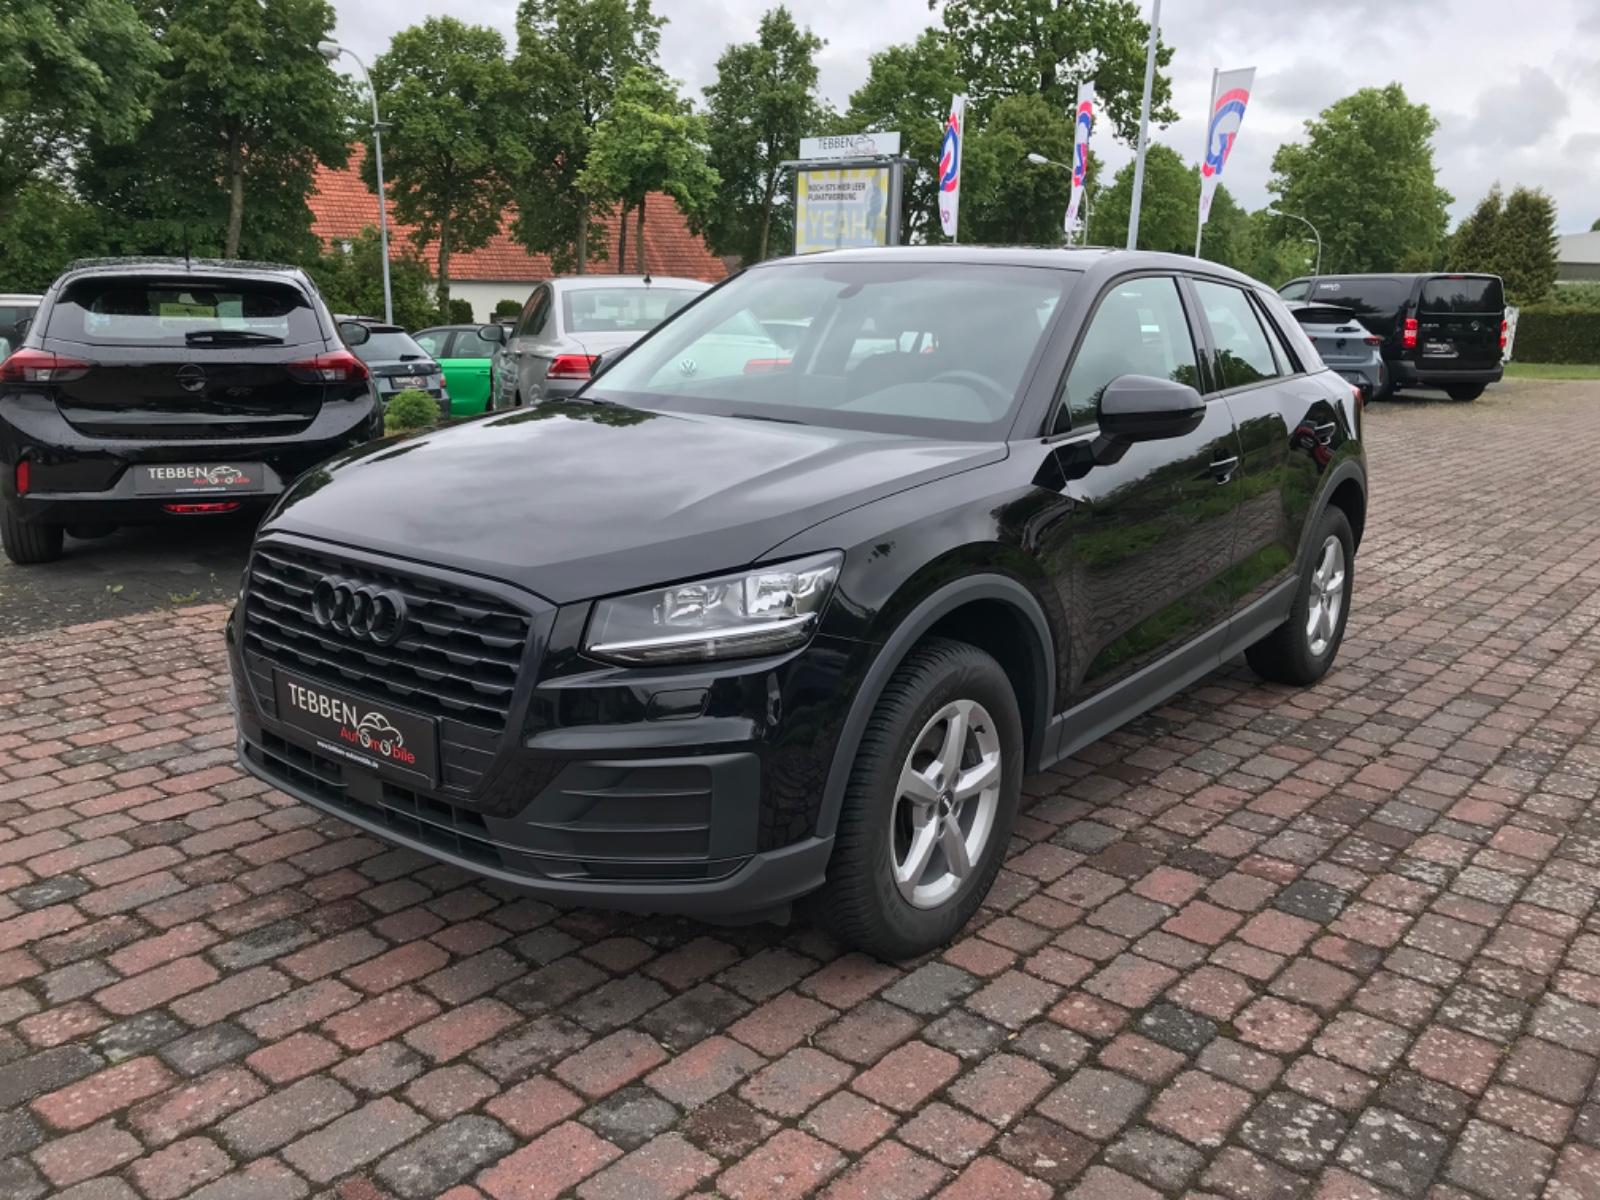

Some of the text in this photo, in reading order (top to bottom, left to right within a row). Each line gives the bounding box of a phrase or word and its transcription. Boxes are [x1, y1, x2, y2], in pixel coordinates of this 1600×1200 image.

[818, 137, 854, 150] TEBBEN
[852, 182, 865, 191] LEER
[148, 466, 207, 479] TEBBEN
[288, 682, 358, 728] TEBBEN
